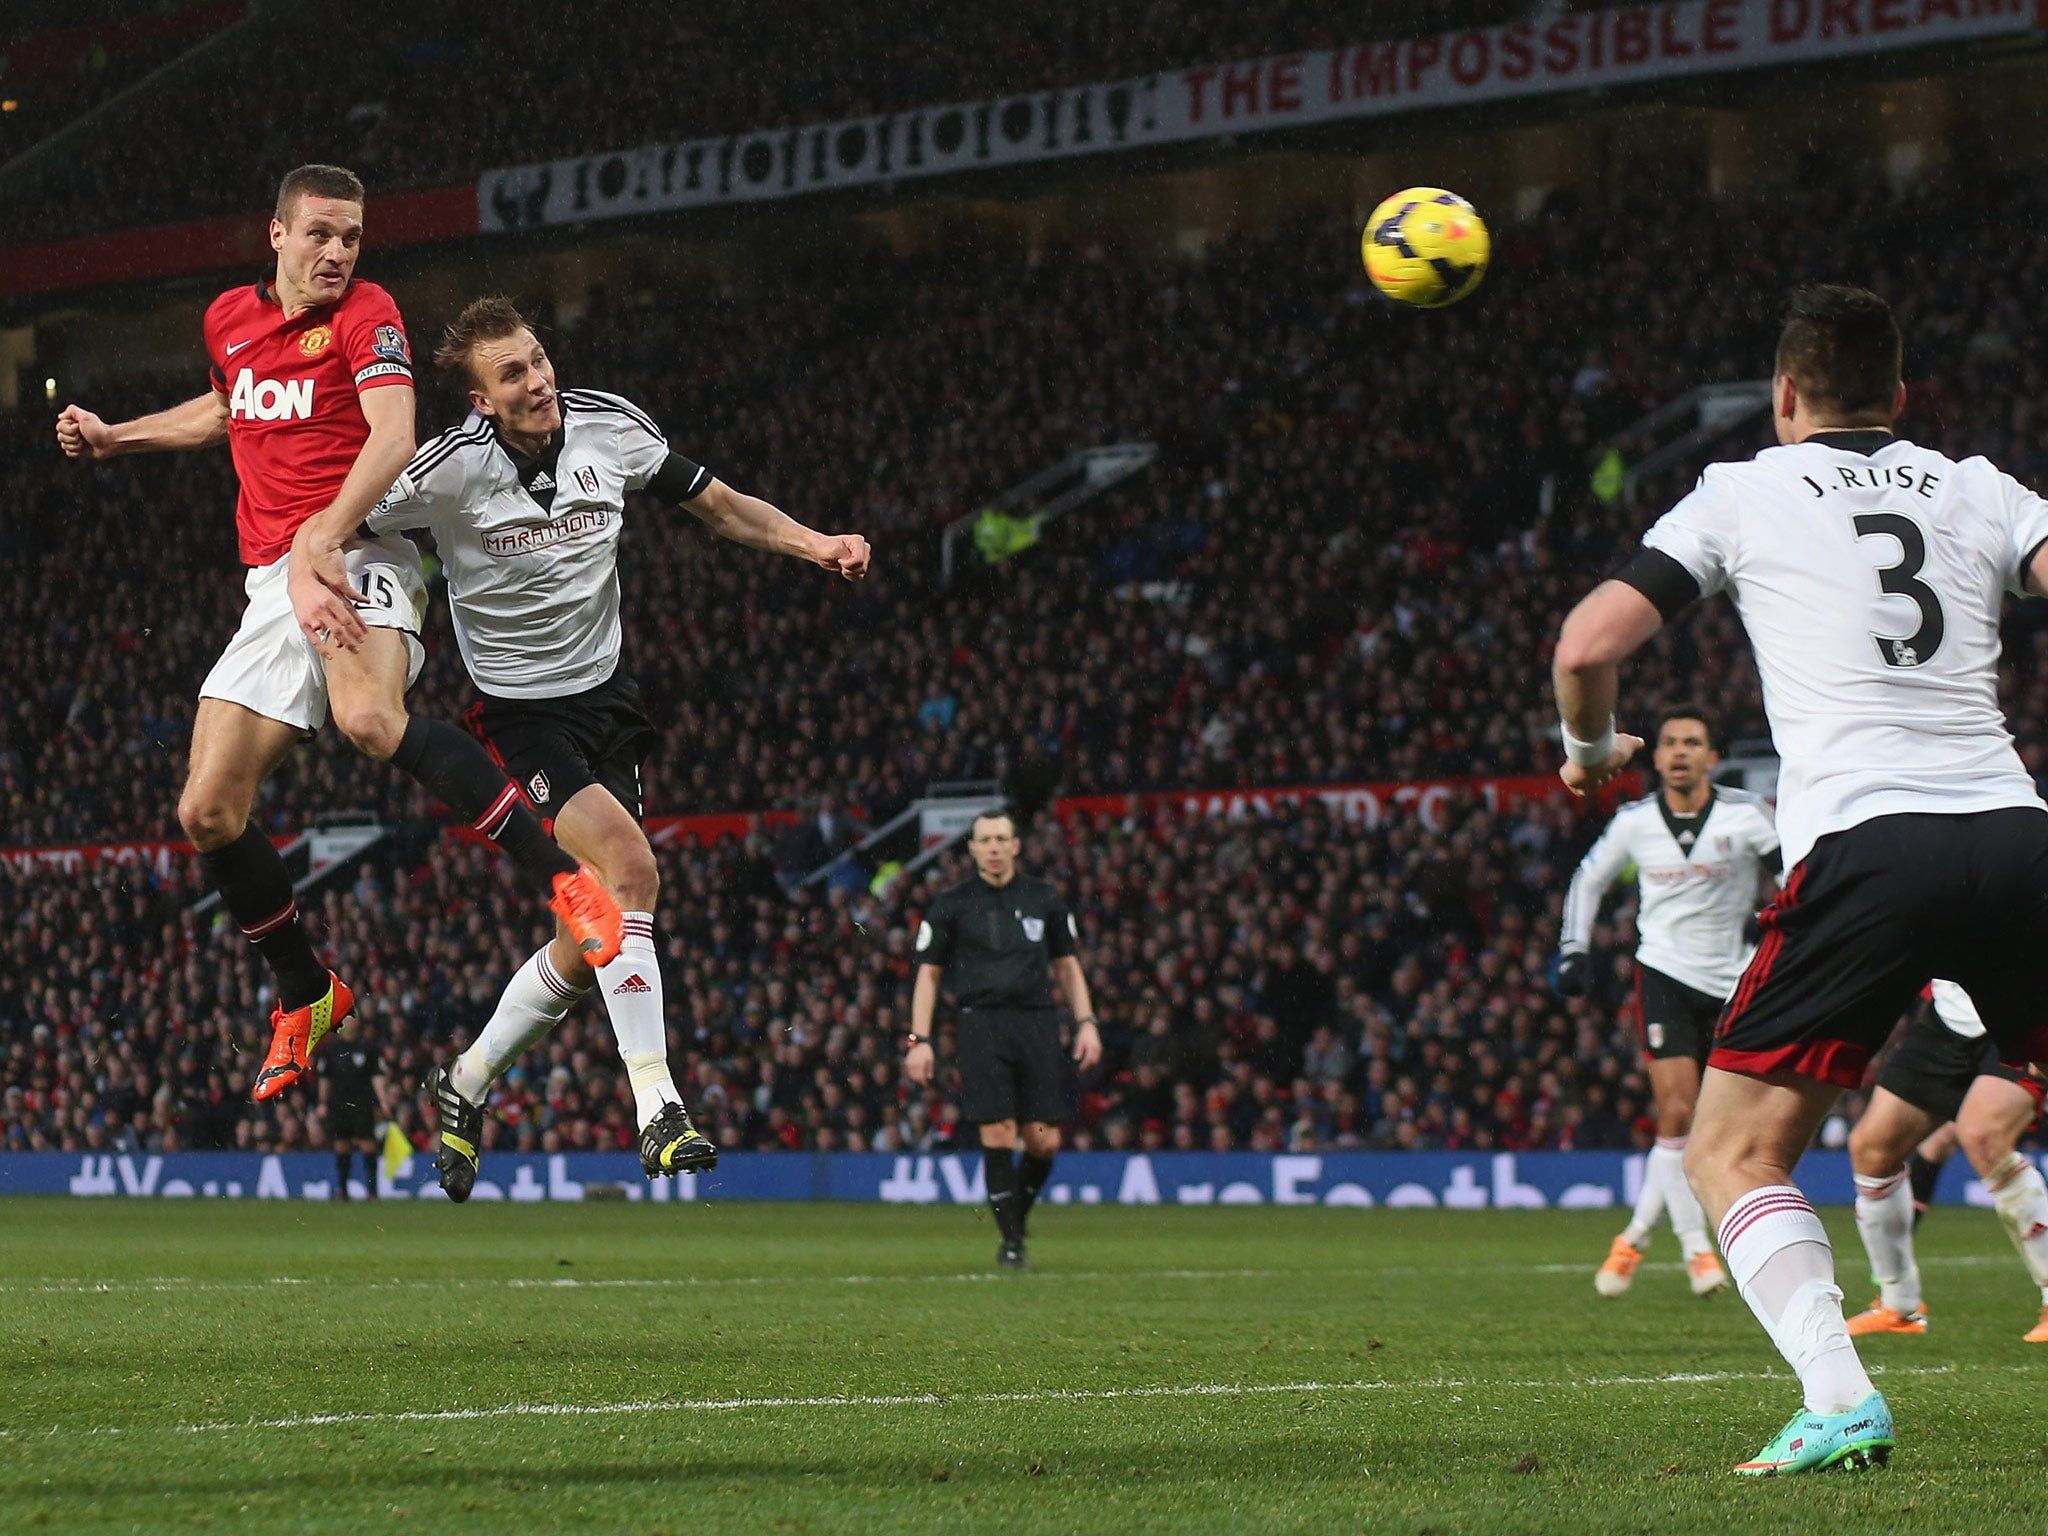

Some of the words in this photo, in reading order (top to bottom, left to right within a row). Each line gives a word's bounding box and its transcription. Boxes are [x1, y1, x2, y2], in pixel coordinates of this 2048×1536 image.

[1182, 56, 1305, 121] THE
[1329, 2, 1740, 101] IMPOSSIBLE
[1768, 0, 2023, 43] DRE
[356, 364, 401, 382] APTAIN
[529, 481, 556, 492] adidas
[582, 470, 596, 492] FFC
[1802, 465, 1940, 498] J.RIISE
[486, 511, 597, 550] MARATHON
[360, 572, 394, 609] 15
[1850, 511, 1945, 668] 3
[613, 985, 652, 996] adidas
[69, 1155, 697, 1199] #YAFtbll
